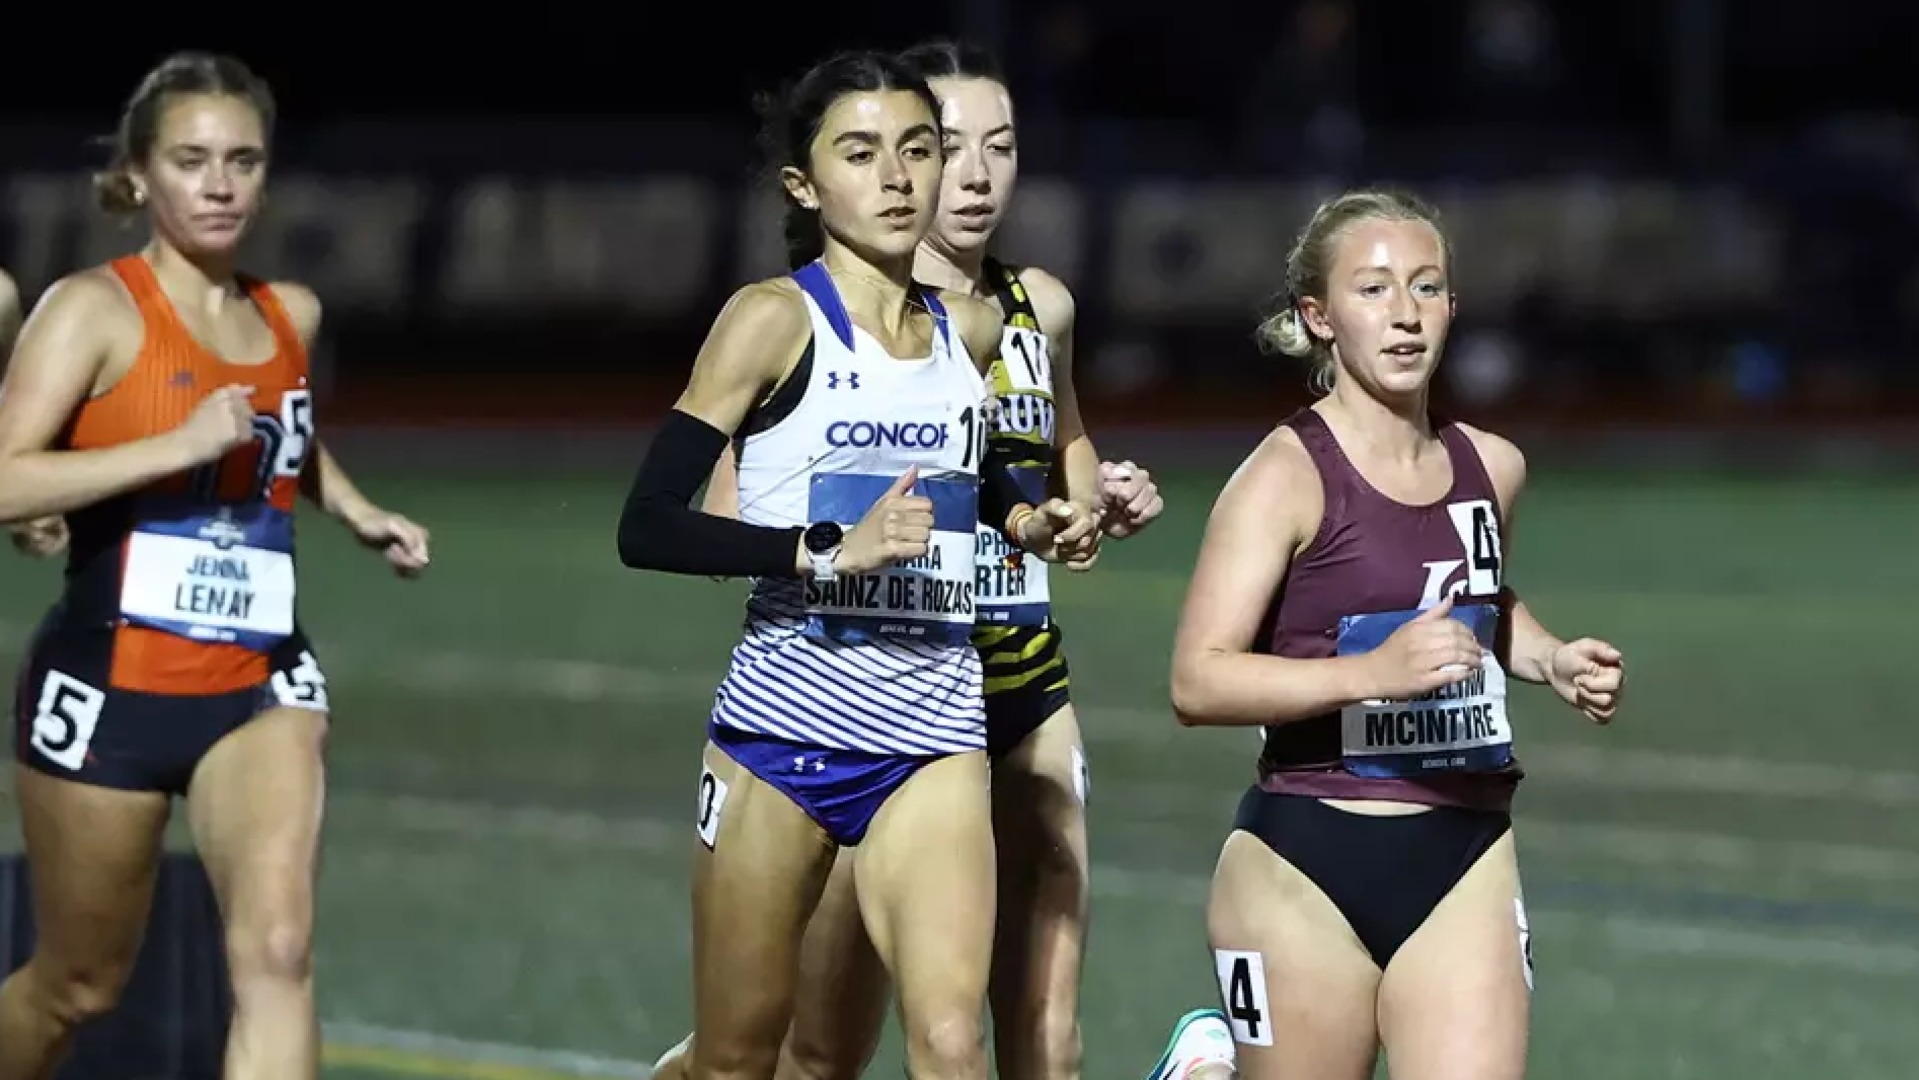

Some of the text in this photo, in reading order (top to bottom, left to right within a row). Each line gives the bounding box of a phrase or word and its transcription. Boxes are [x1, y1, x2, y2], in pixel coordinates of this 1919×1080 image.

[286, 398, 309, 469] 5
[1471, 506, 1499, 587] 4
[174, 583, 256, 619] LENAY
[804, 575, 973, 615] SAINZ DE ROZAS
[40, 683, 88, 752] 5
[1365, 703, 1498, 747] MCINTYRE
[1231, 957, 1262, 1038] 4
